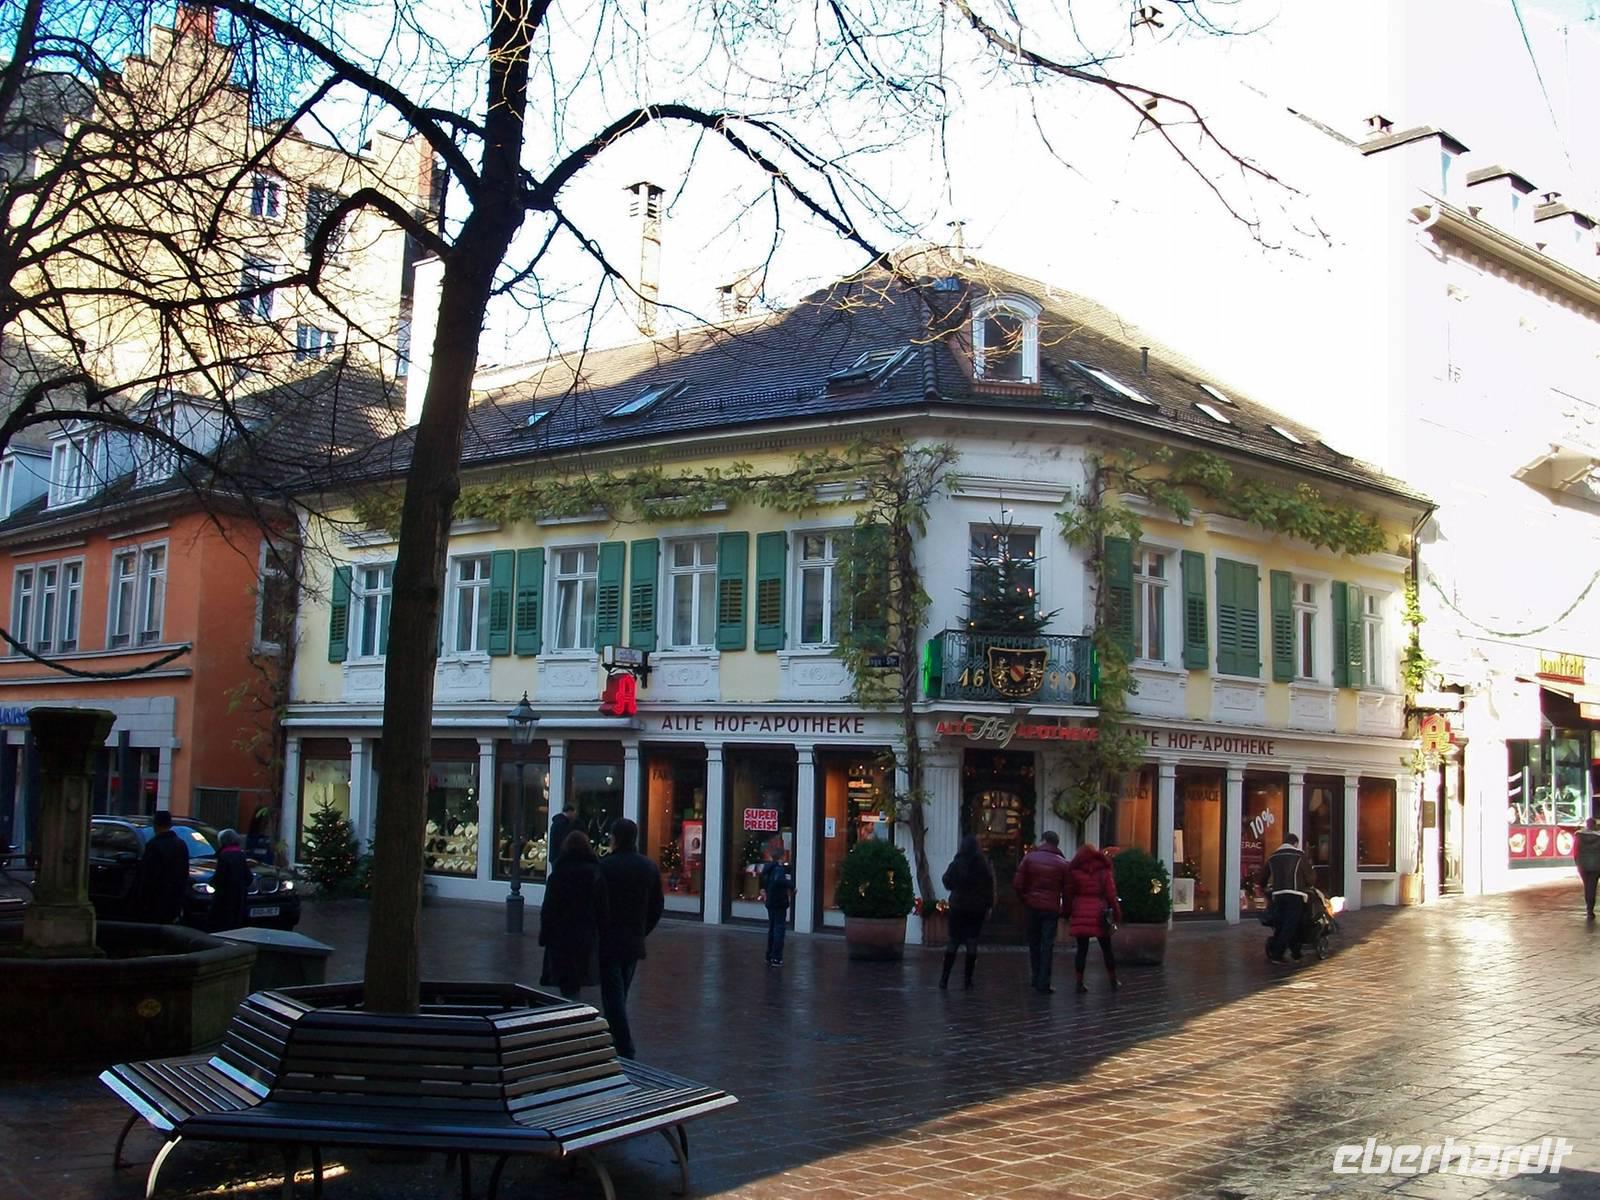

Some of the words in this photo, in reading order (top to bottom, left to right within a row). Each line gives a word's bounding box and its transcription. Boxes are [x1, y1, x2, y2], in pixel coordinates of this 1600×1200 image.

[661, 715, 704, 731] ALTE
[714, 715, 865, 734] HOF-APOTHEKE
[935, 719, 974, 737] ALTE
[963, 714, 1023, 749] Hof
[1168, 732, 1275, 756] HOF-APOTHEKE
[745, 809, 777, 820] SUPER
[1249, 807, 1275, 839] 10%
[745, 820, 777, 831] PREISE
